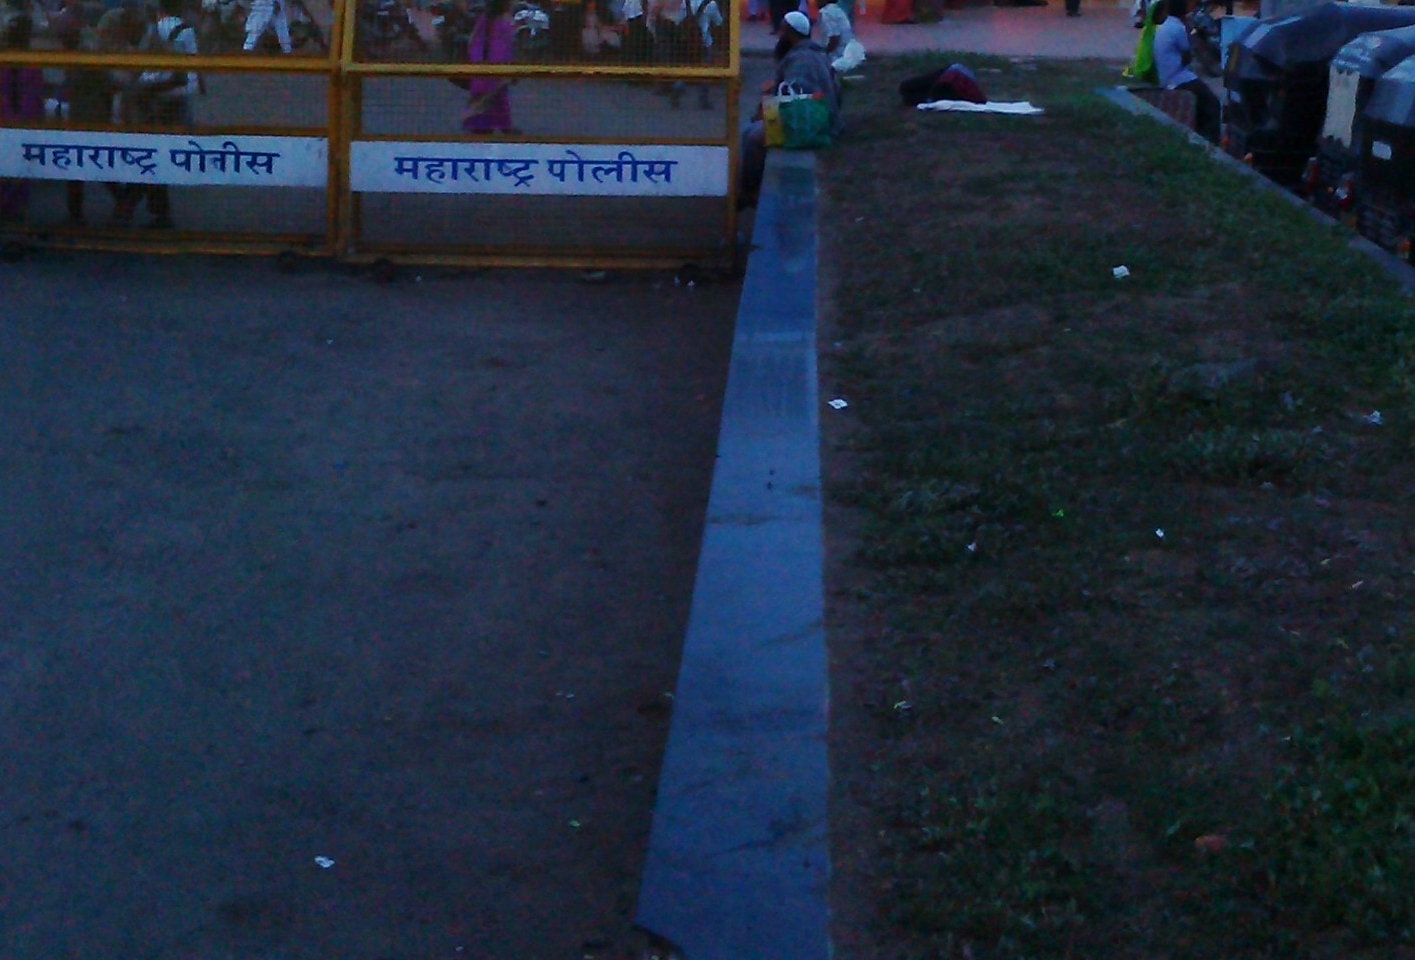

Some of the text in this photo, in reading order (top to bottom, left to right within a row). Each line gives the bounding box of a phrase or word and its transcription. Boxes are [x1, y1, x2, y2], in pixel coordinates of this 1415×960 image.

[21, 143, 158, 175] महाराष्ट्र
[394, 150, 678, 187] महाराष्ट्र पोलीस
